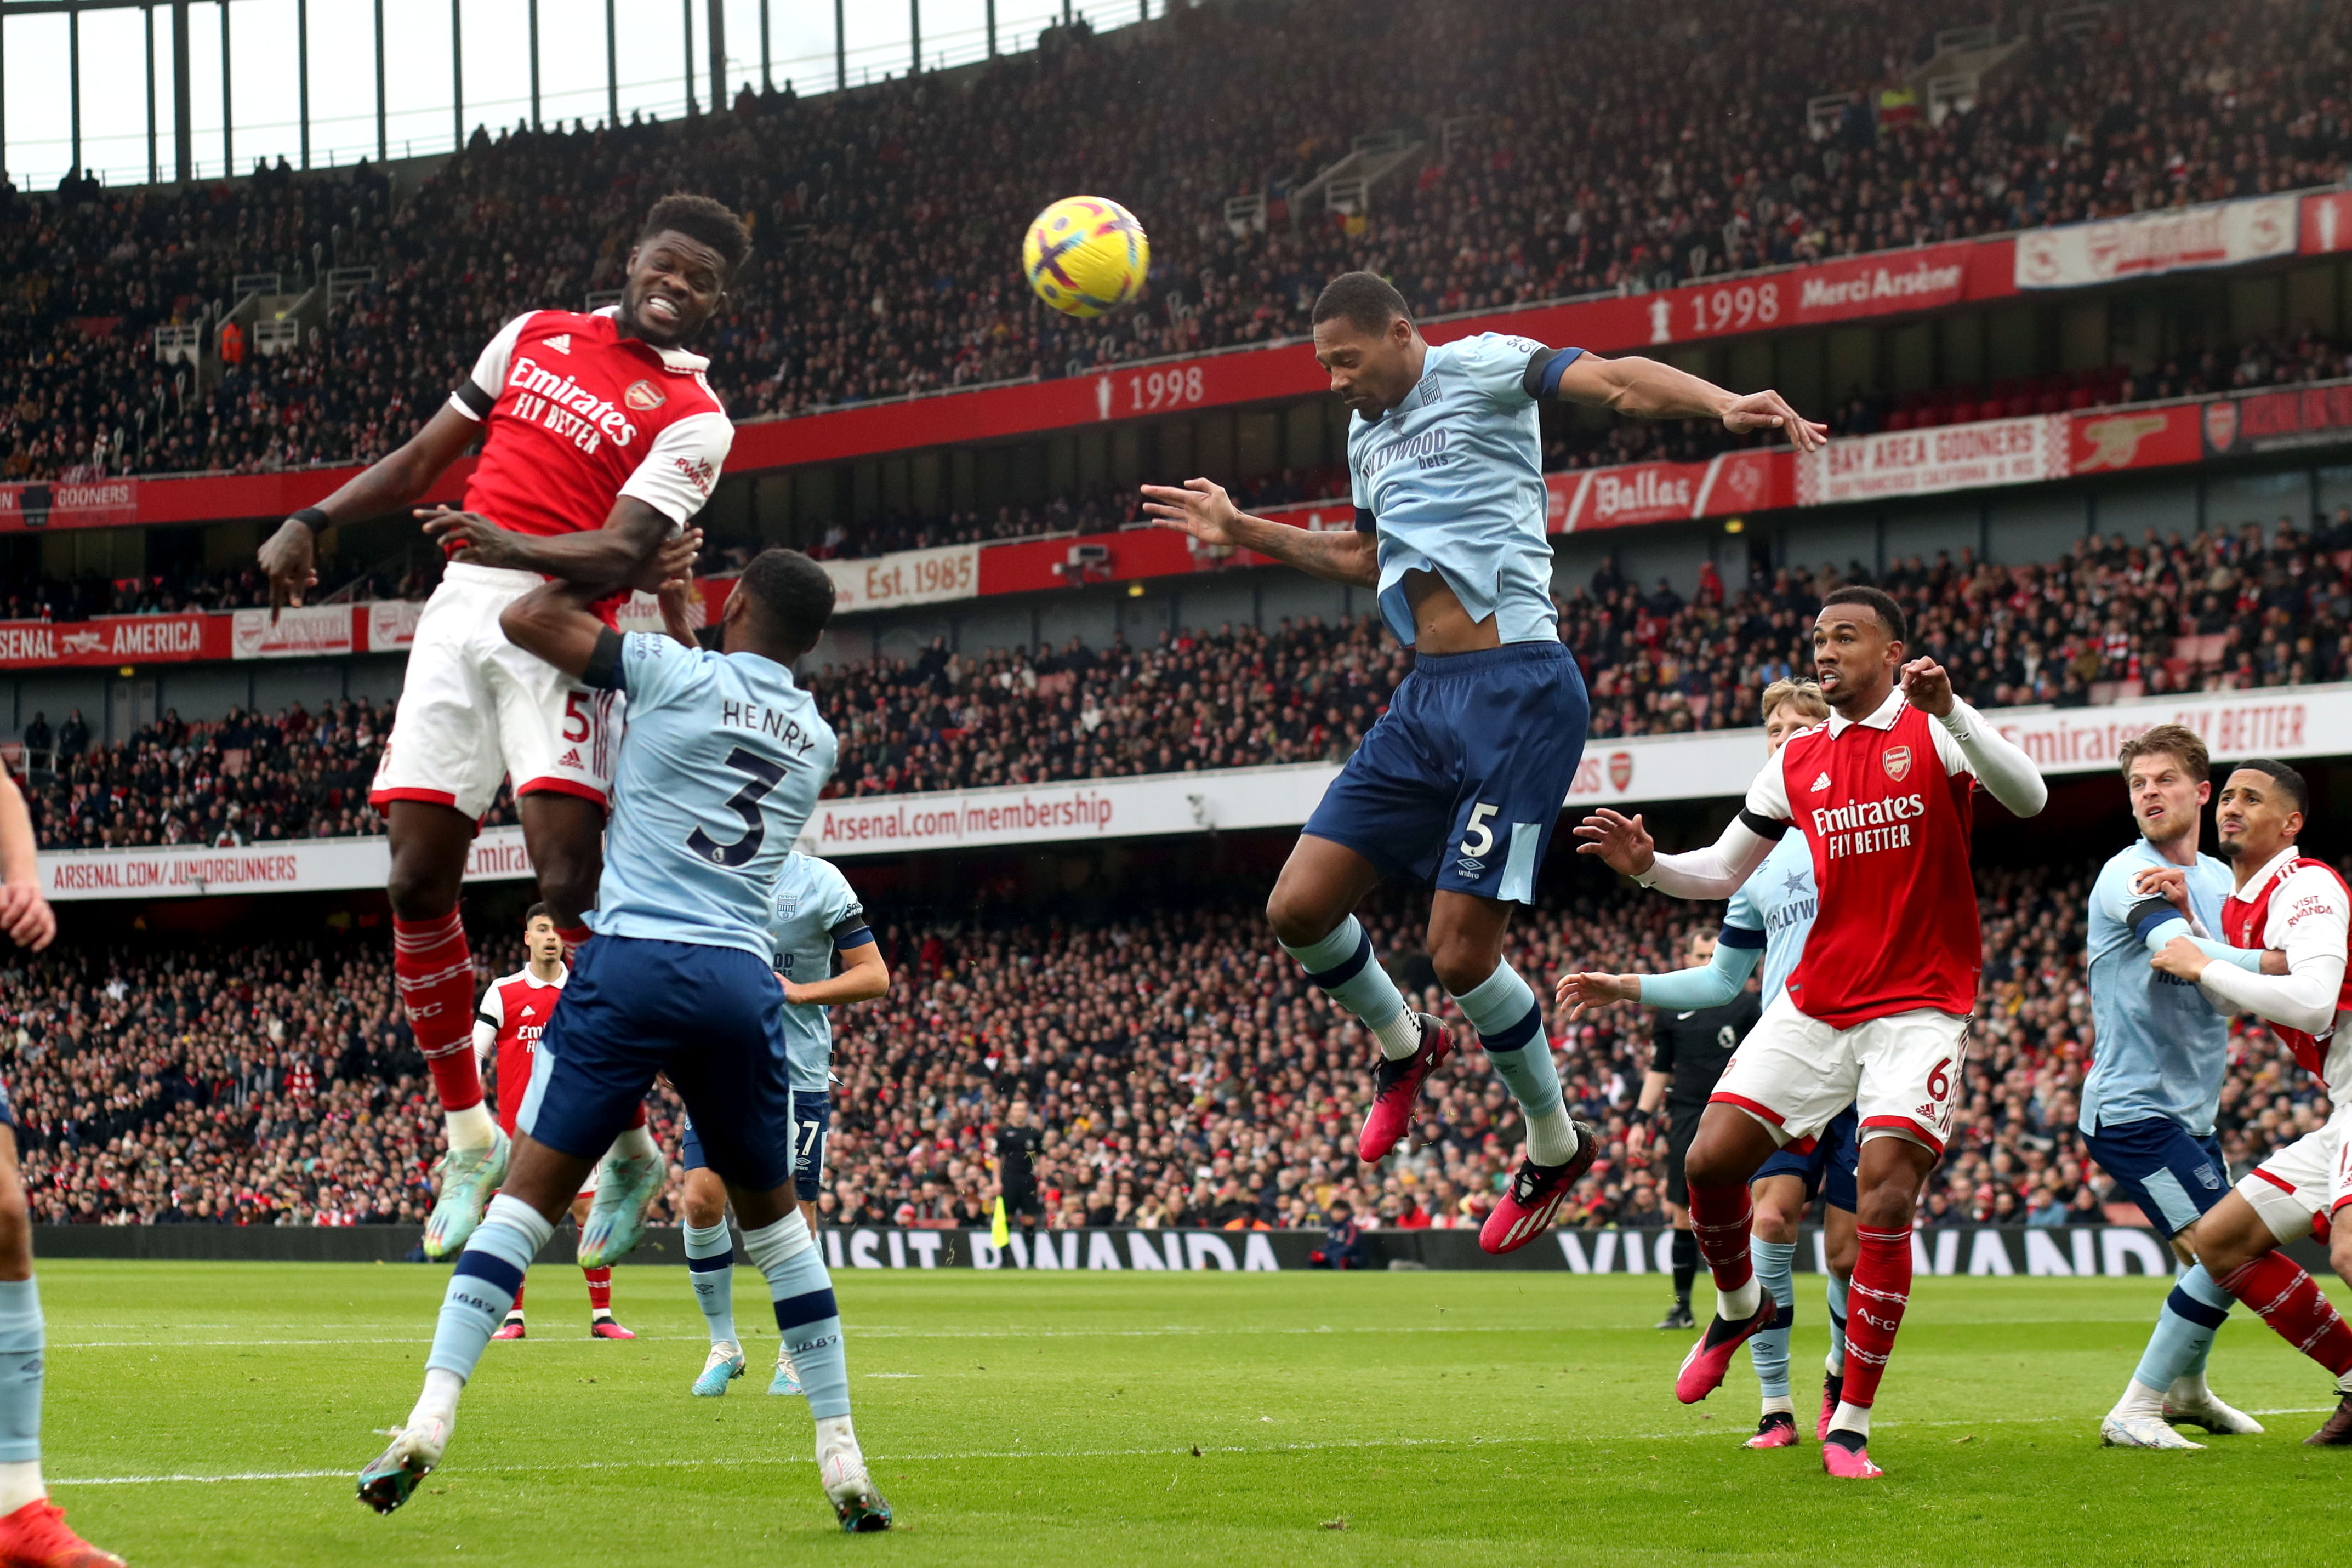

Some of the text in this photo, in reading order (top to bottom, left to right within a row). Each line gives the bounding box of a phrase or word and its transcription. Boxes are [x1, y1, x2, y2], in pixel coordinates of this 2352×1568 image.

[1690, 283, 1780, 332] 1998
[509, 357, 637, 447] Emirates
[1129, 367, 1203, 409] 1998
[511, 392, 601, 455] FLY BETTER
[1417, 454, 1448, 470] bets
[1873, 437, 1927, 468] AREA
[57, 484, 129, 508] GOONERS
[865, 556, 973, 600] Est. 1985
[112, 620, 201, 655] AMERICA
[562, 691, 591, 743] 5
[722, 699, 816, 757] HENRY
[2219, 704, 2305, 751] BETTER
[685, 745, 789, 868] 3
[1810, 780, 1832, 793] adidas
[821, 790, 1112, 842] Arsenal.com/membership
[1460, 802, 1499, 858] 5
[1811, 794, 1925, 837] Emirates
[1829, 824, 1911, 860] FLY BETTER
[54, 856, 297, 890] ARSENAL.COM/JUNIORGUNNERS
[1458, 869, 1479, 880] umbro
[2287, 905, 2333, 928] RWANDA
[2292, 895, 2319, 910] VISIT
[1927, 1057, 1952, 1102] 6
[1857, 1308, 1897, 1331] AFC
